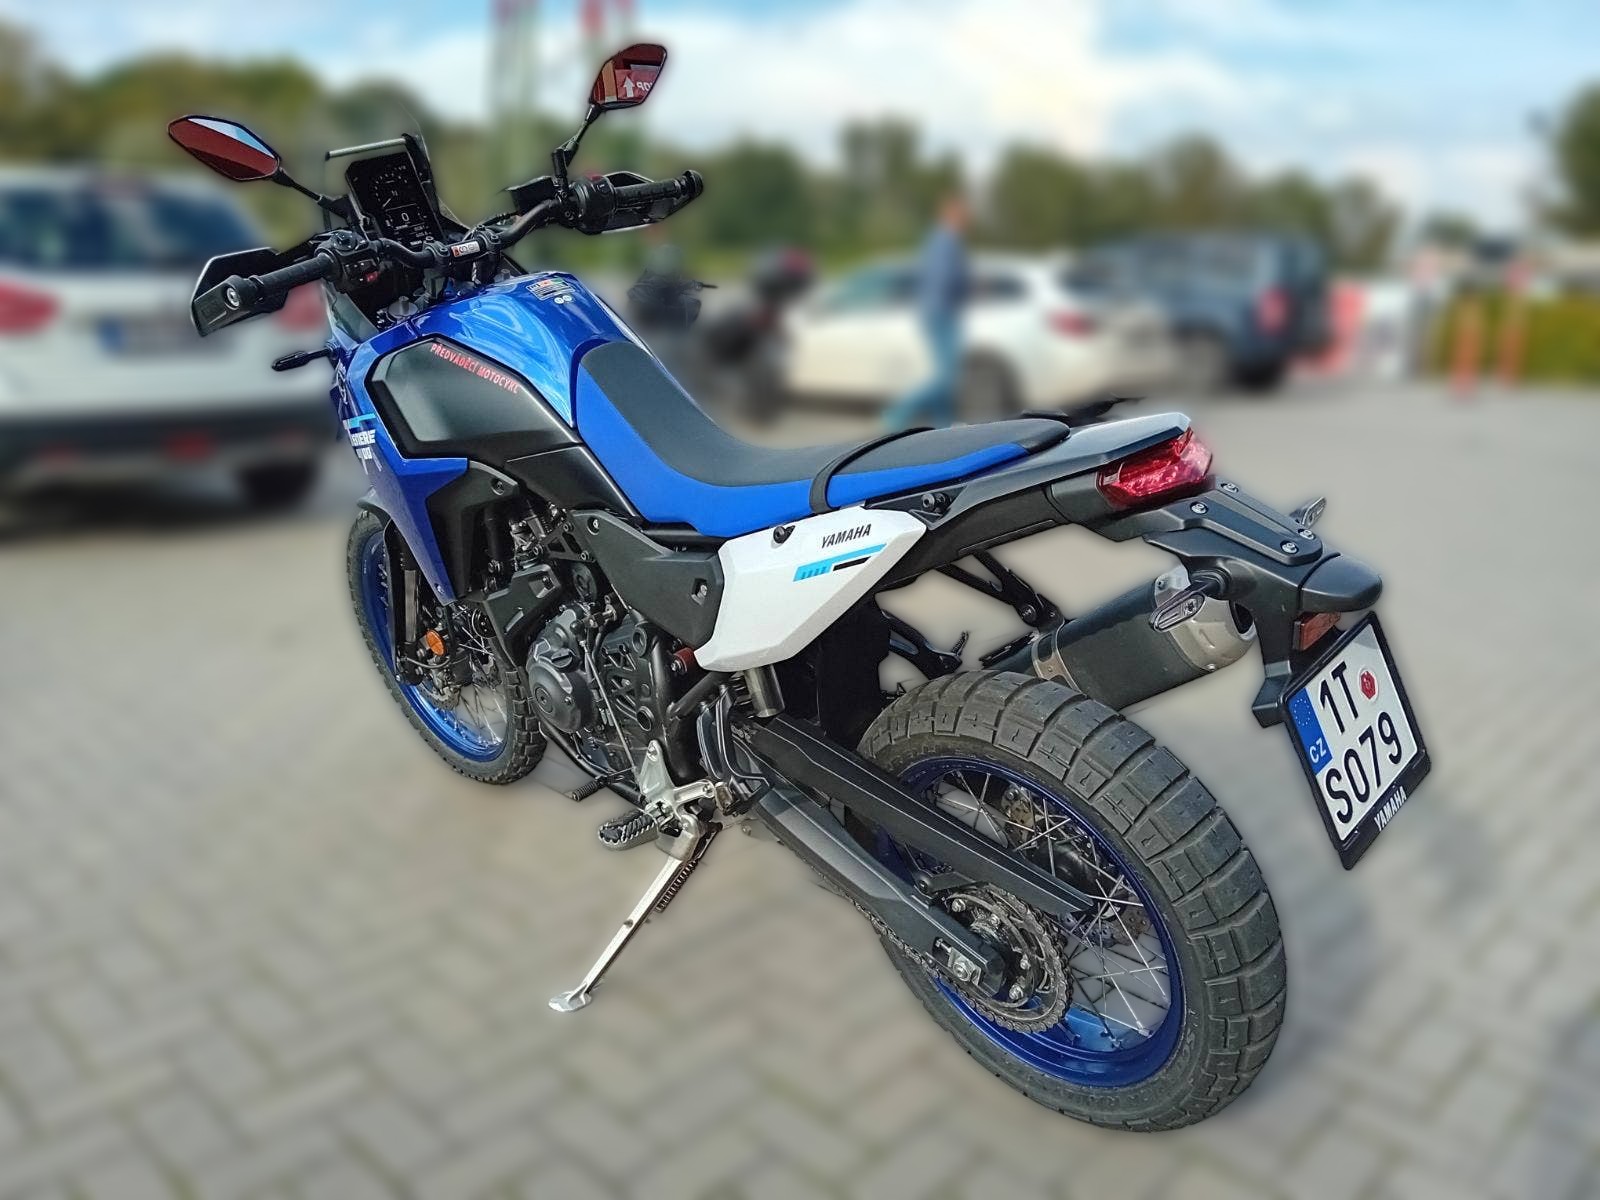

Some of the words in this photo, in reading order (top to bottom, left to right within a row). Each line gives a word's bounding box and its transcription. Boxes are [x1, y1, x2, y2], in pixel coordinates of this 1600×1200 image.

[476, 365, 520, 394] MOTOCYKL
[821, 523, 872, 549] YAMAHA
[1319, 662, 1358, 734] 1T
[1309, 738, 1327, 764] CZ
[1325, 711, 1402, 824] S079
[1373, 786, 1407, 831] YAMAHA
